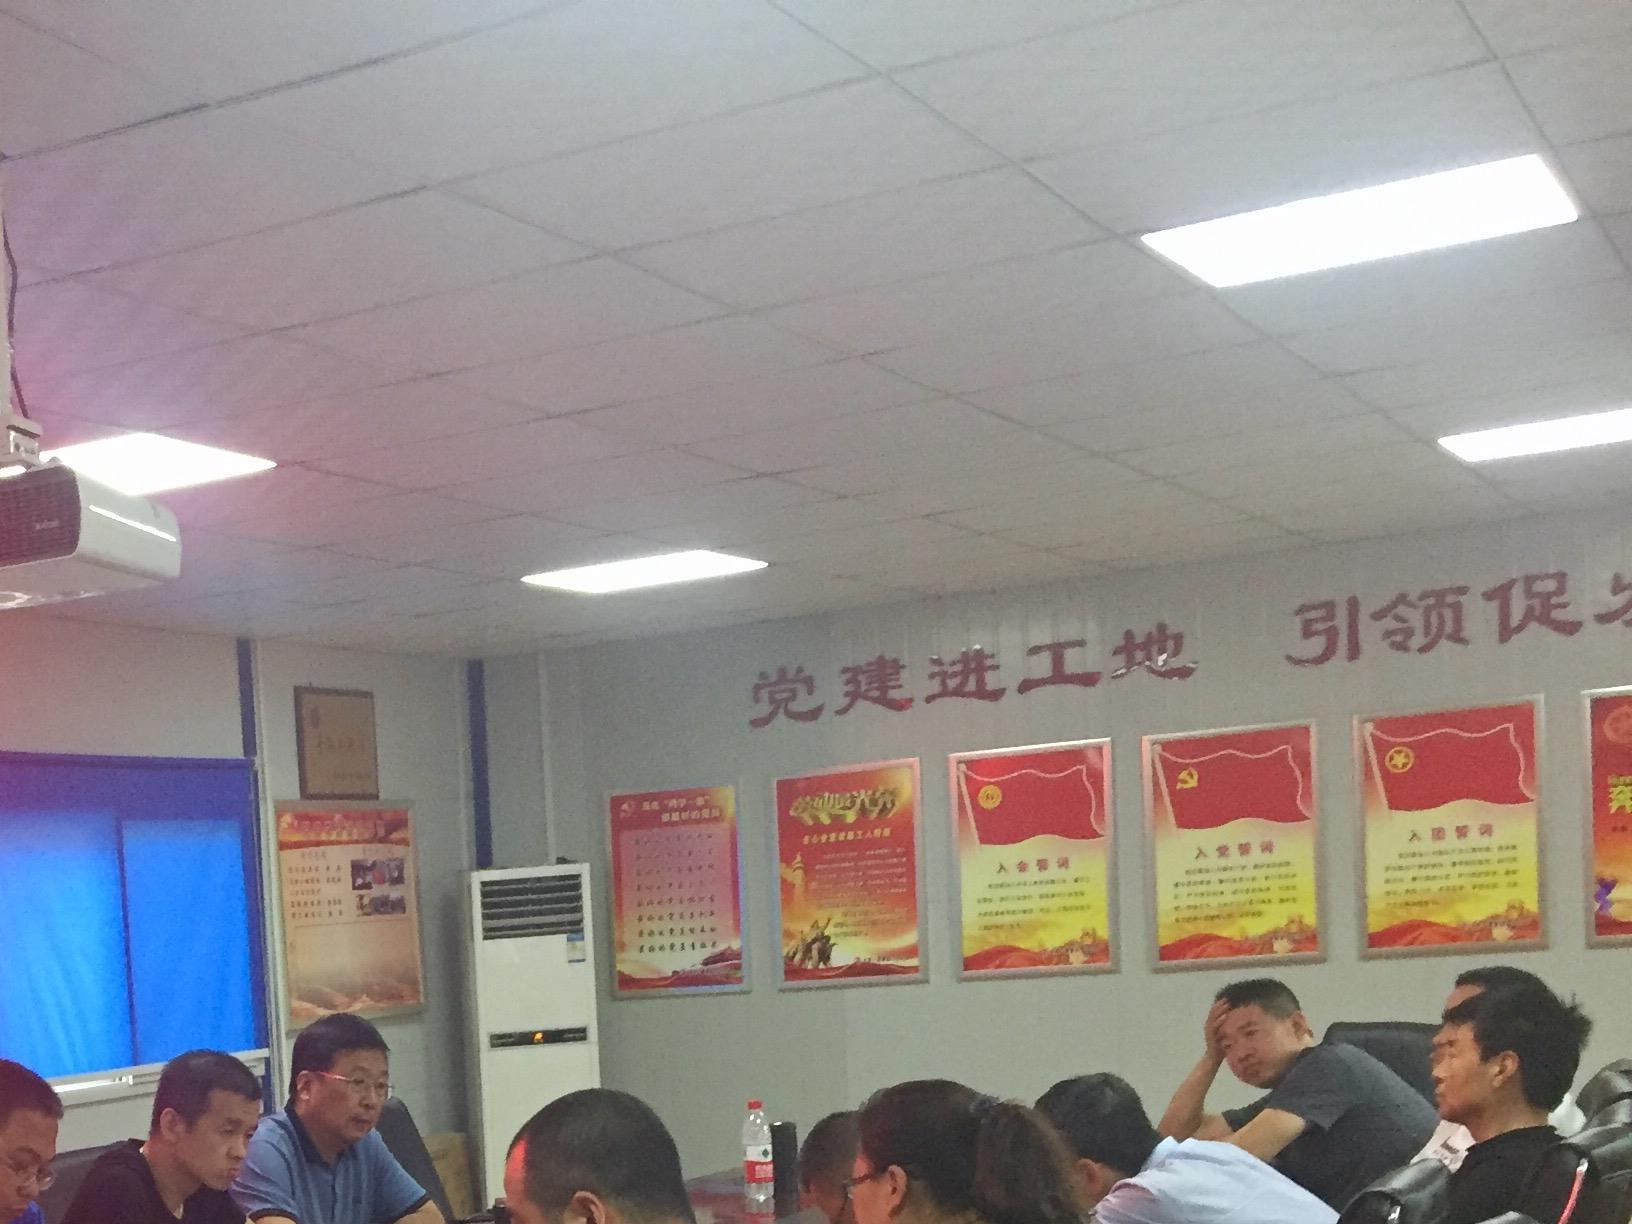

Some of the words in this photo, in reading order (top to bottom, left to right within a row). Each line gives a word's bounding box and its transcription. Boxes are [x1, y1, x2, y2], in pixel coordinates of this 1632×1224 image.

[748, 621, 1199, 729] 党建进工地
